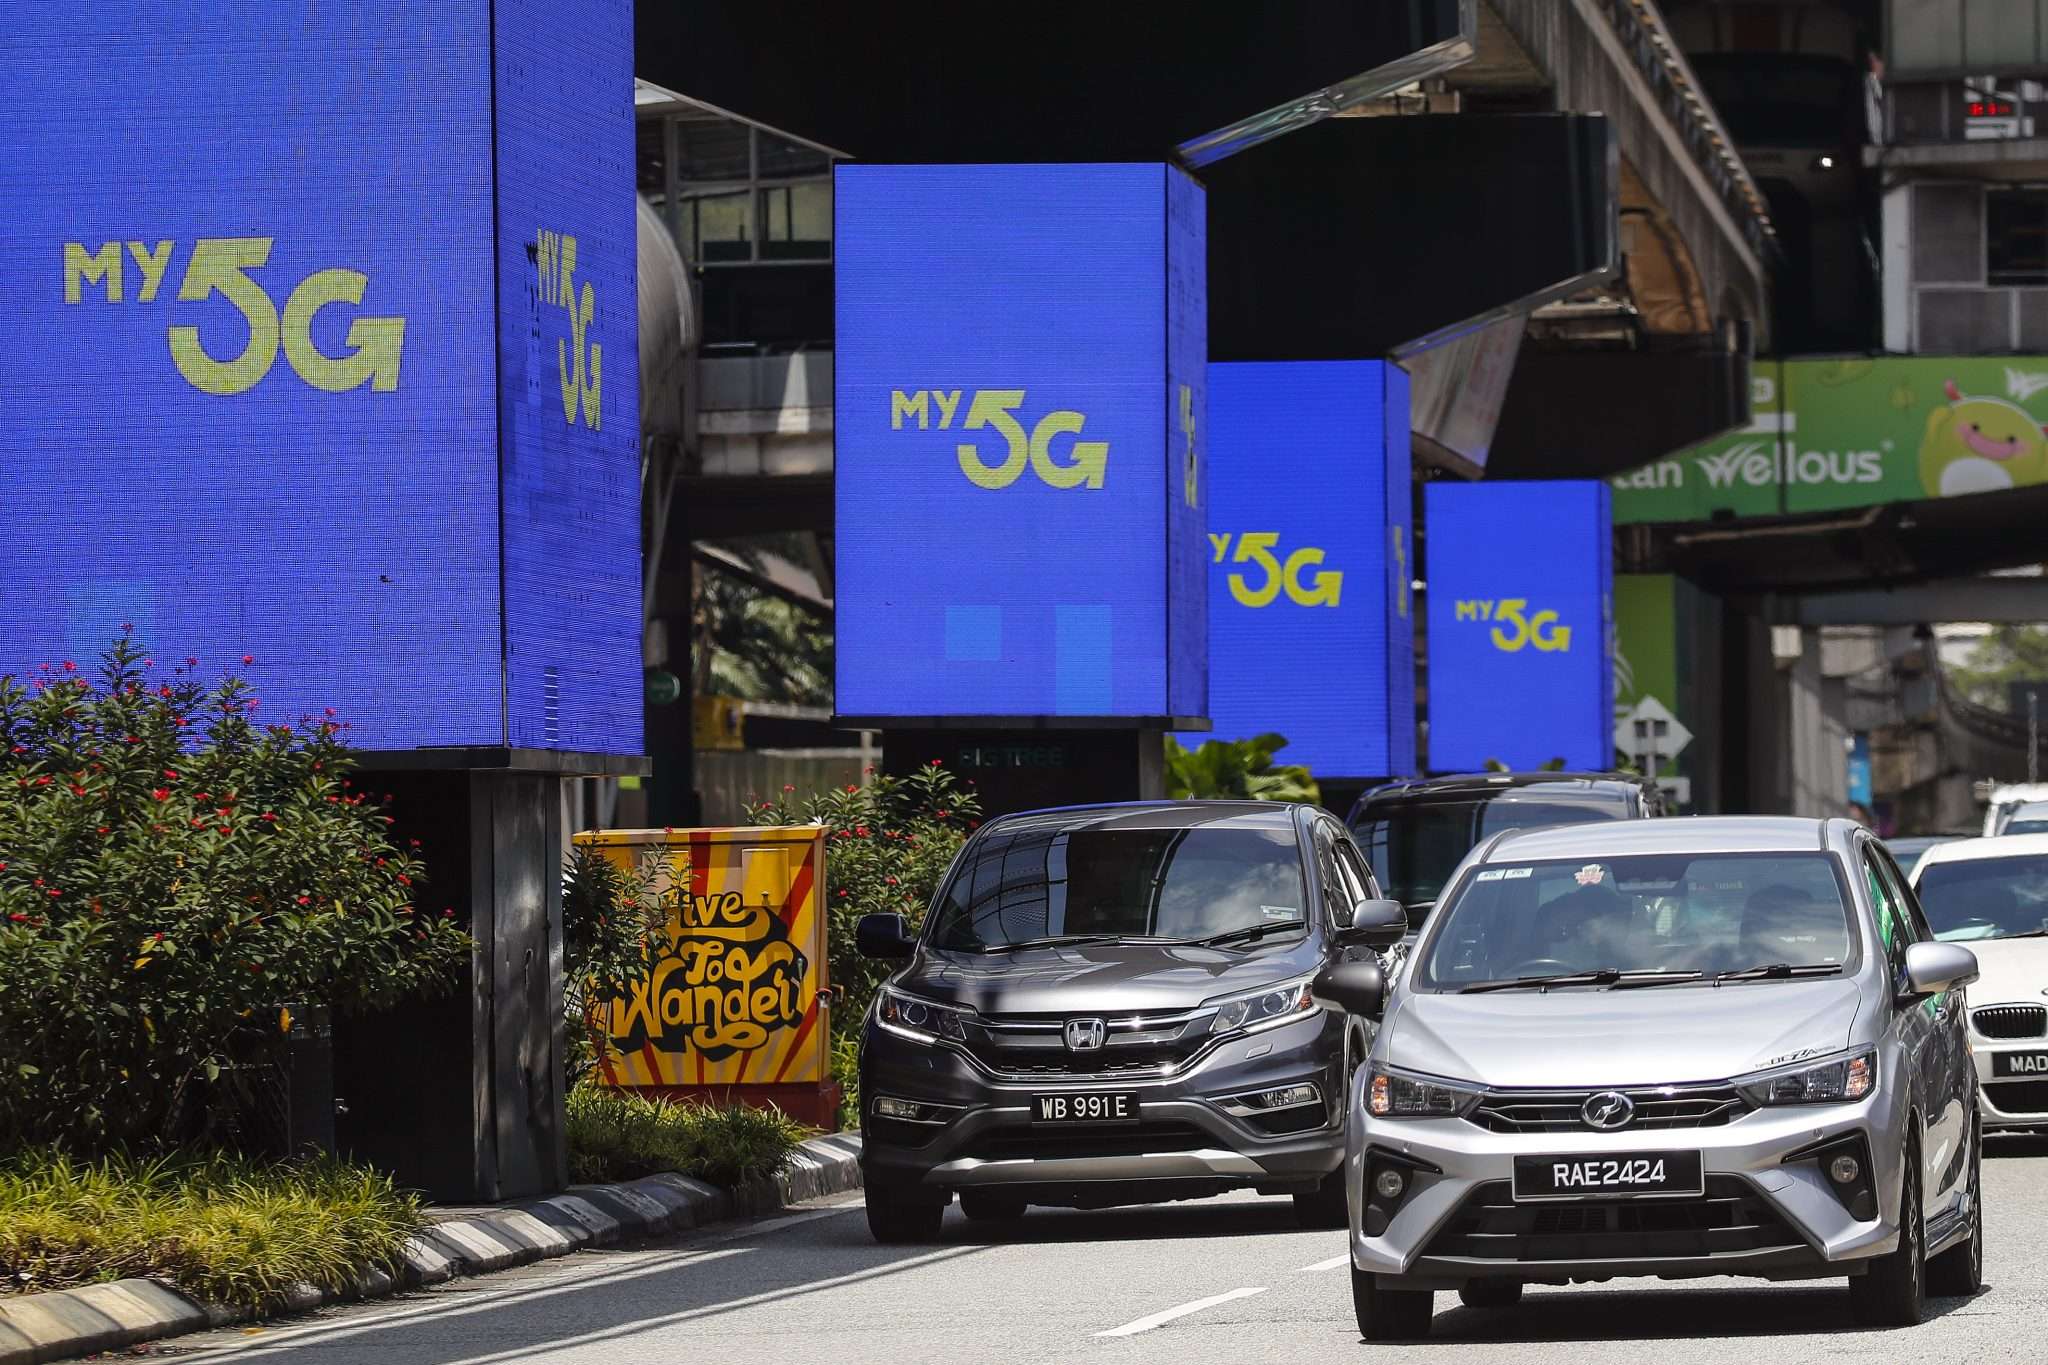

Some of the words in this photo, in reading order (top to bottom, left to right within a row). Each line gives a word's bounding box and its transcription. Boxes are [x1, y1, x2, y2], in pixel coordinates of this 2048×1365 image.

[1697, 441, 1883, 488] Wellous
[679, 940, 725, 986] To
[2009, 1054, 2048, 1073] MAD
[1040, 1098, 1067, 1119] WB
